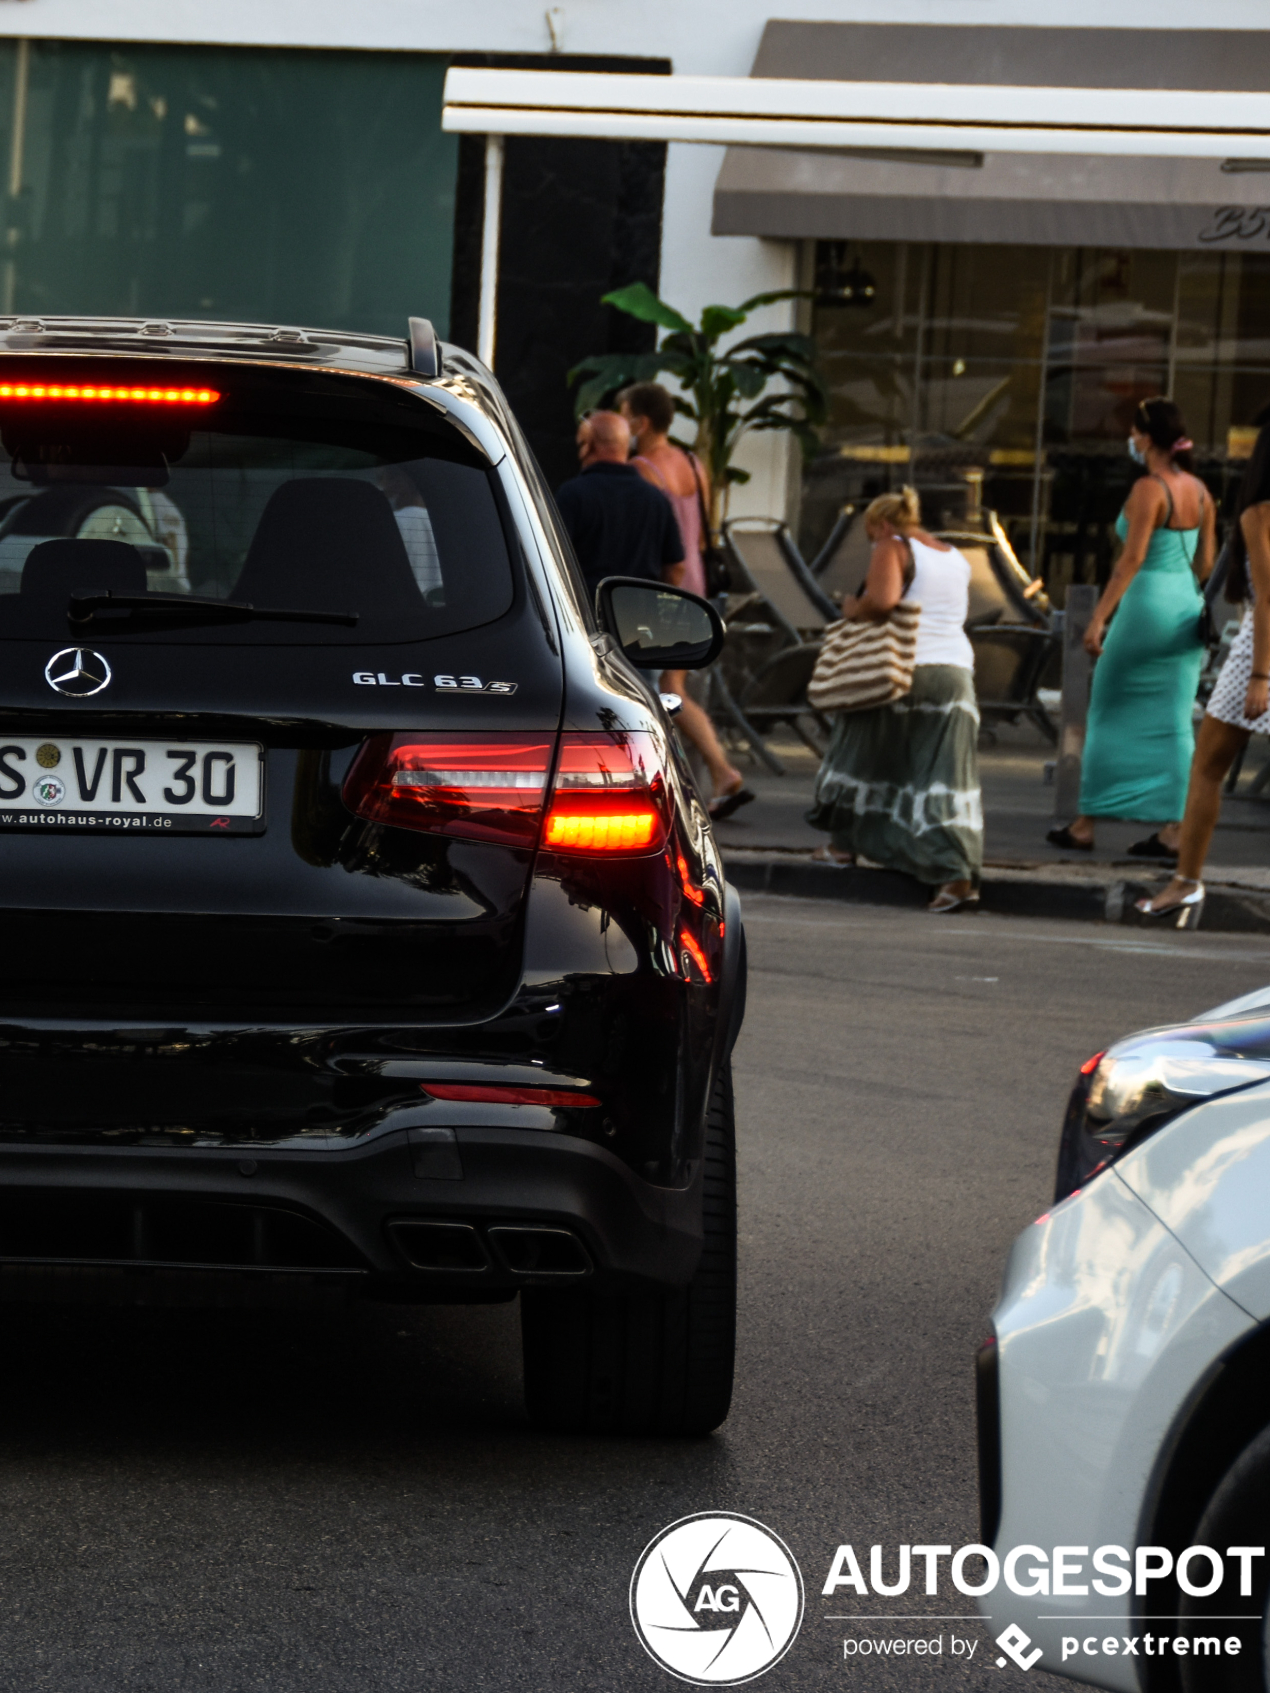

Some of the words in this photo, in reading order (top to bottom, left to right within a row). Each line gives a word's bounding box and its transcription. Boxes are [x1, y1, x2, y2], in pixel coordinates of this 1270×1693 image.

[351, 671, 425, 687] GLC
[72, 746, 147, 804] VR
[163, 749, 236, 806] 30
